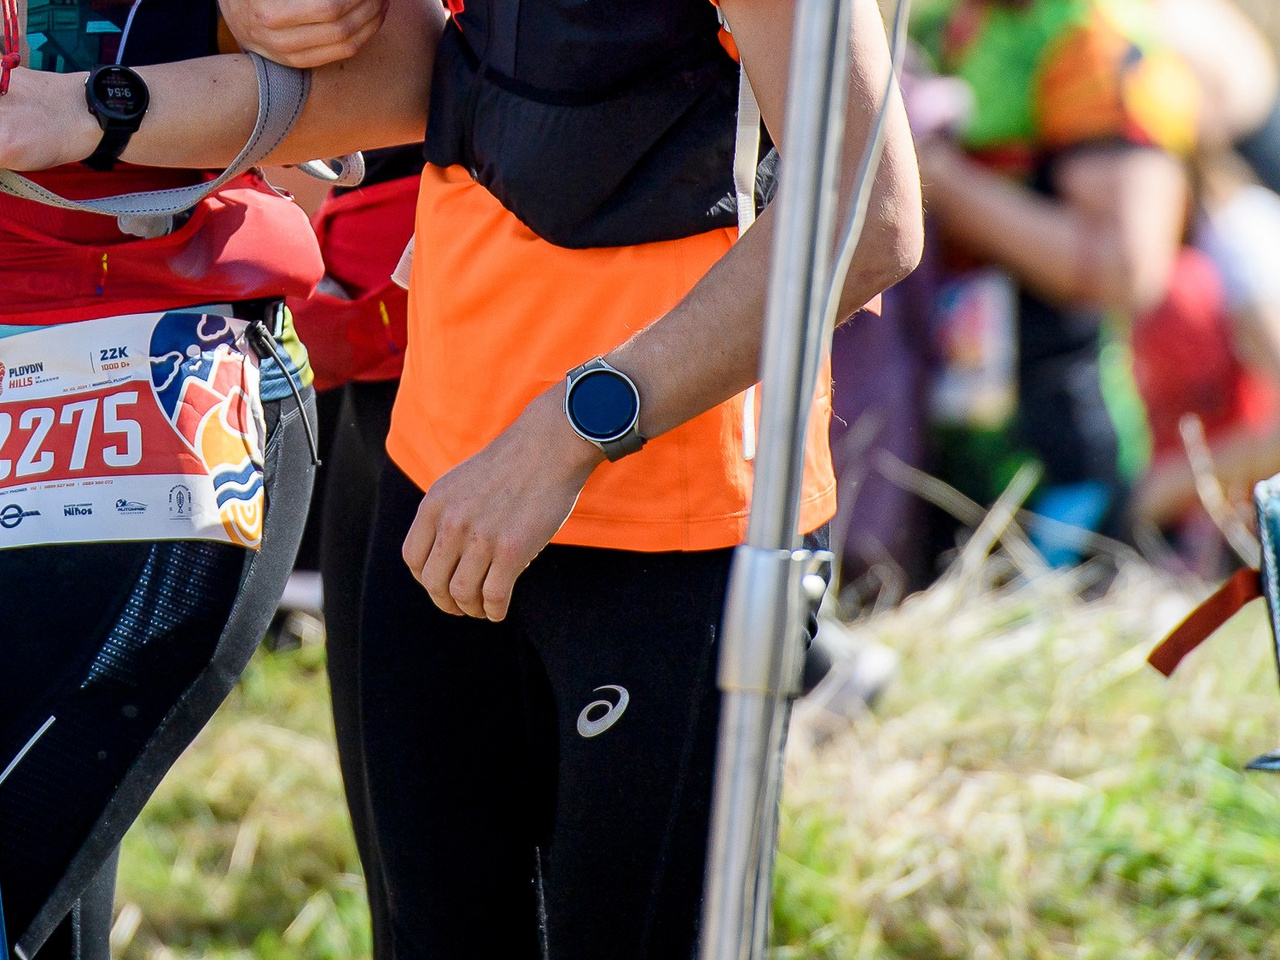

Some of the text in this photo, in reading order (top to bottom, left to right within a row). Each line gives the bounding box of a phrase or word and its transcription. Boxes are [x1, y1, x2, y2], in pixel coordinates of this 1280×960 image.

[9, 362, 44, 378] PLOVDIV
[101, 363, 119, 372] 1000
[9, 377, 33, 389] HILLS
